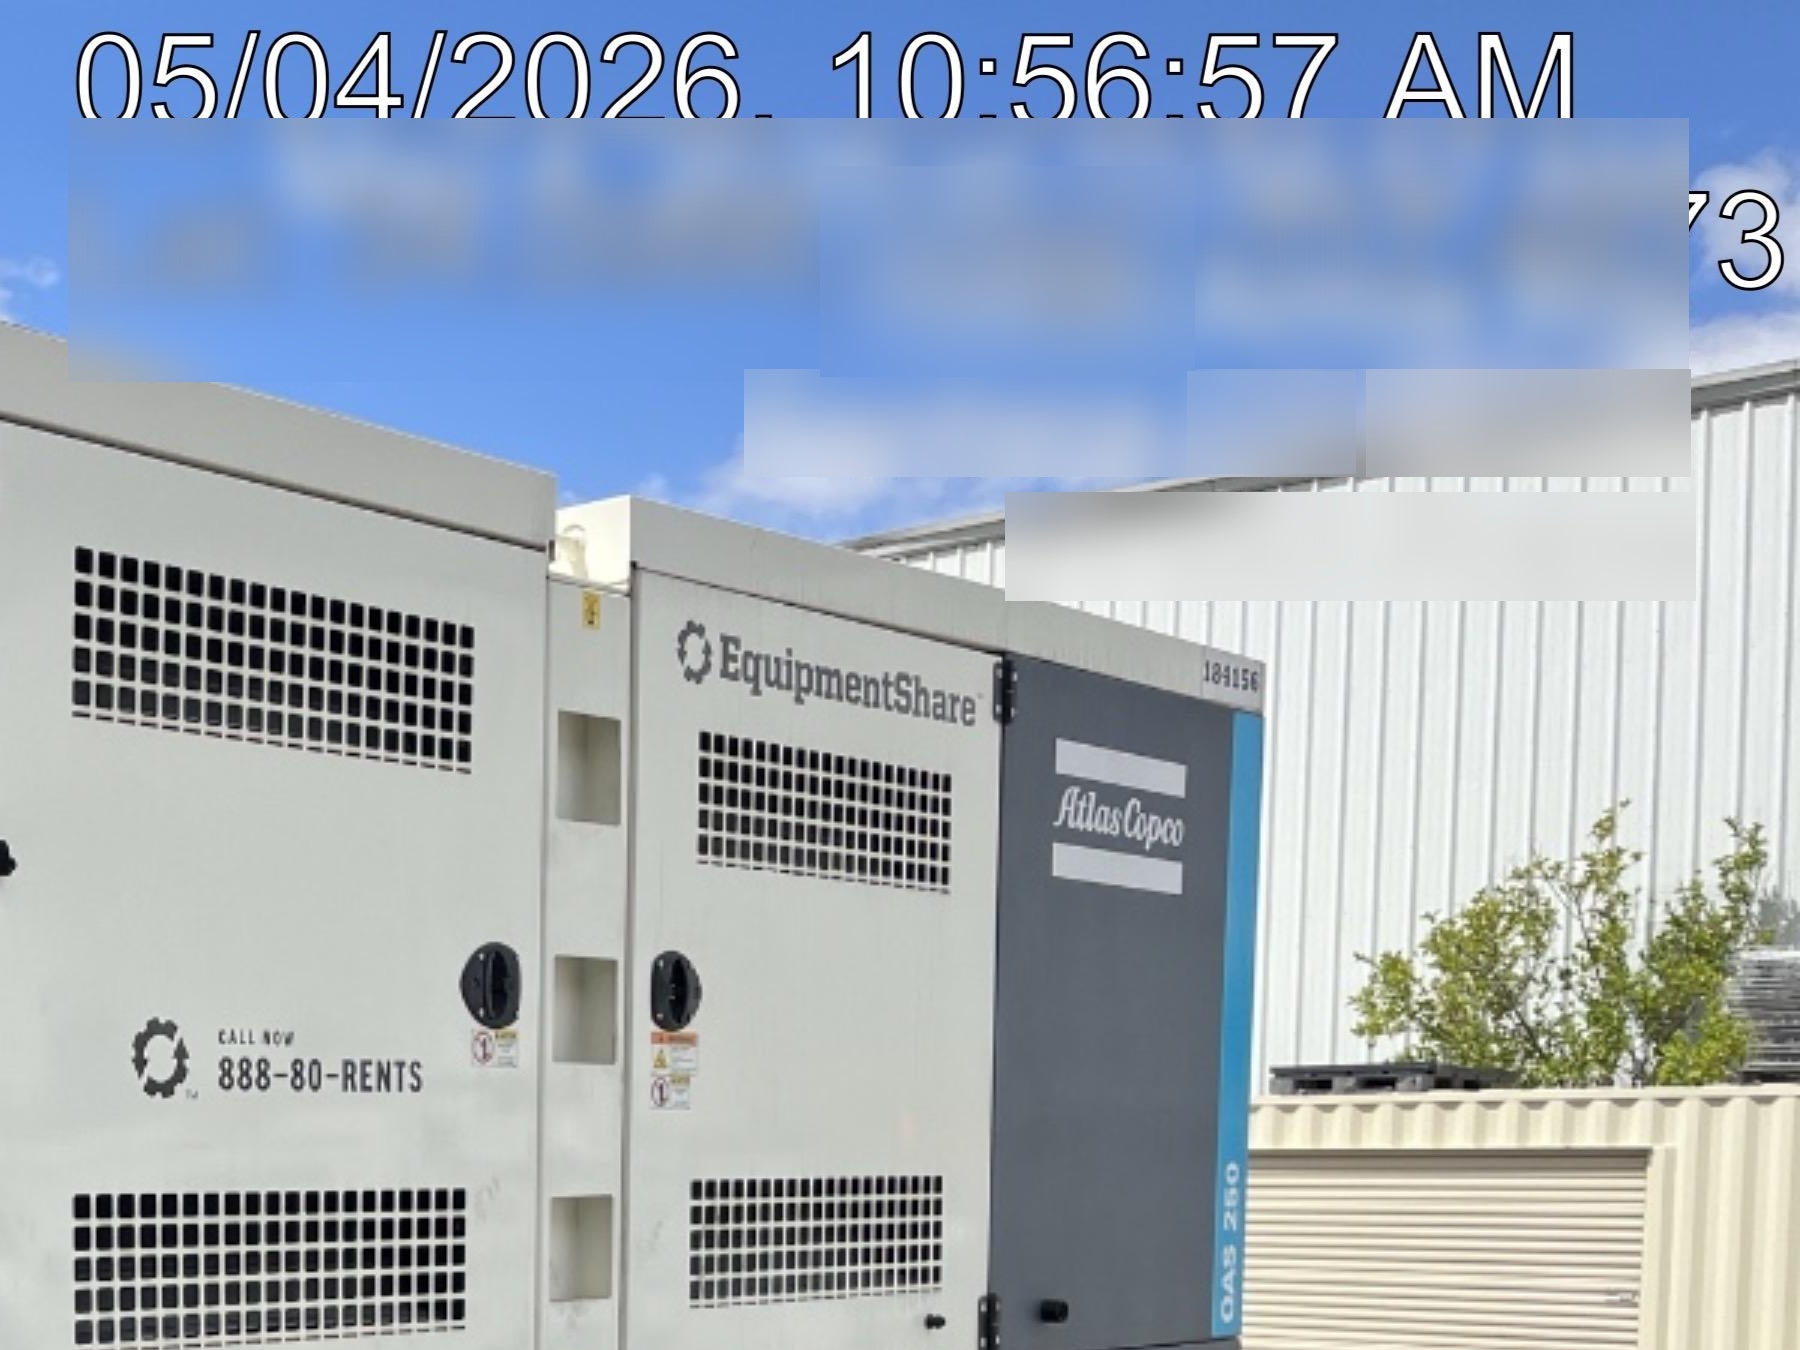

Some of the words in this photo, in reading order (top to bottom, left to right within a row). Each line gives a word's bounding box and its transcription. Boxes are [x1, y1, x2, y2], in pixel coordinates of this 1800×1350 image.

[719, 632, 977, 726] EquipmentShare
[1052, 785, 1124, 837] Atlas
[1123, 797, 1186, 851] Copco
[218, 1029, 256, 1045] CALL
[263, 1030, 295, 1046] NOW
[218, 1056, 424, 1093] 888-80-RENTS
